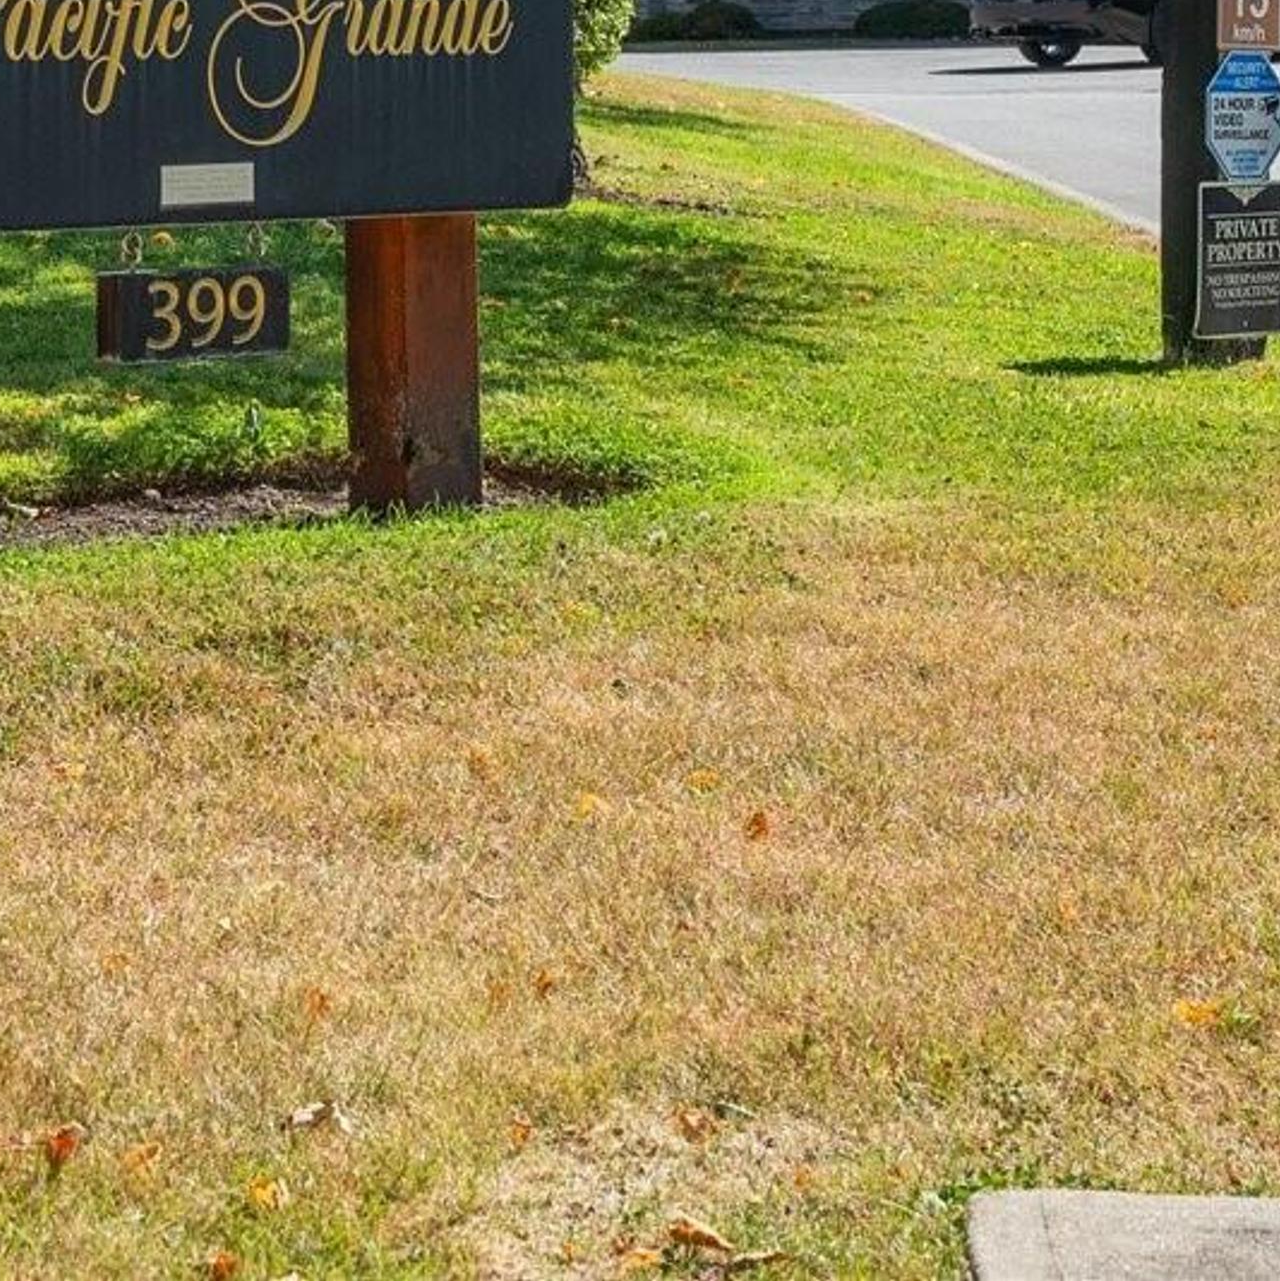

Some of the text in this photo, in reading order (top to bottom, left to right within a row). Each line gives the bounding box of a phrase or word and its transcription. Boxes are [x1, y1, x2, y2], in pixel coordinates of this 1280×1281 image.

[1233, 23, 1265, 41] km/h
[1214, 97, 1256, 111] 24 HOUR
[1214, 113, 1244, 127] VIDEO
[1214, 129, 1271, 140] SURVEILLANCE
[1215, 218, 1279, 239] PRIVATE
[1205, 275, 1222, 287] NO
[1211, 285, 1280, 300] NO SOLICITING
[145, 274, 267, 351] 399
